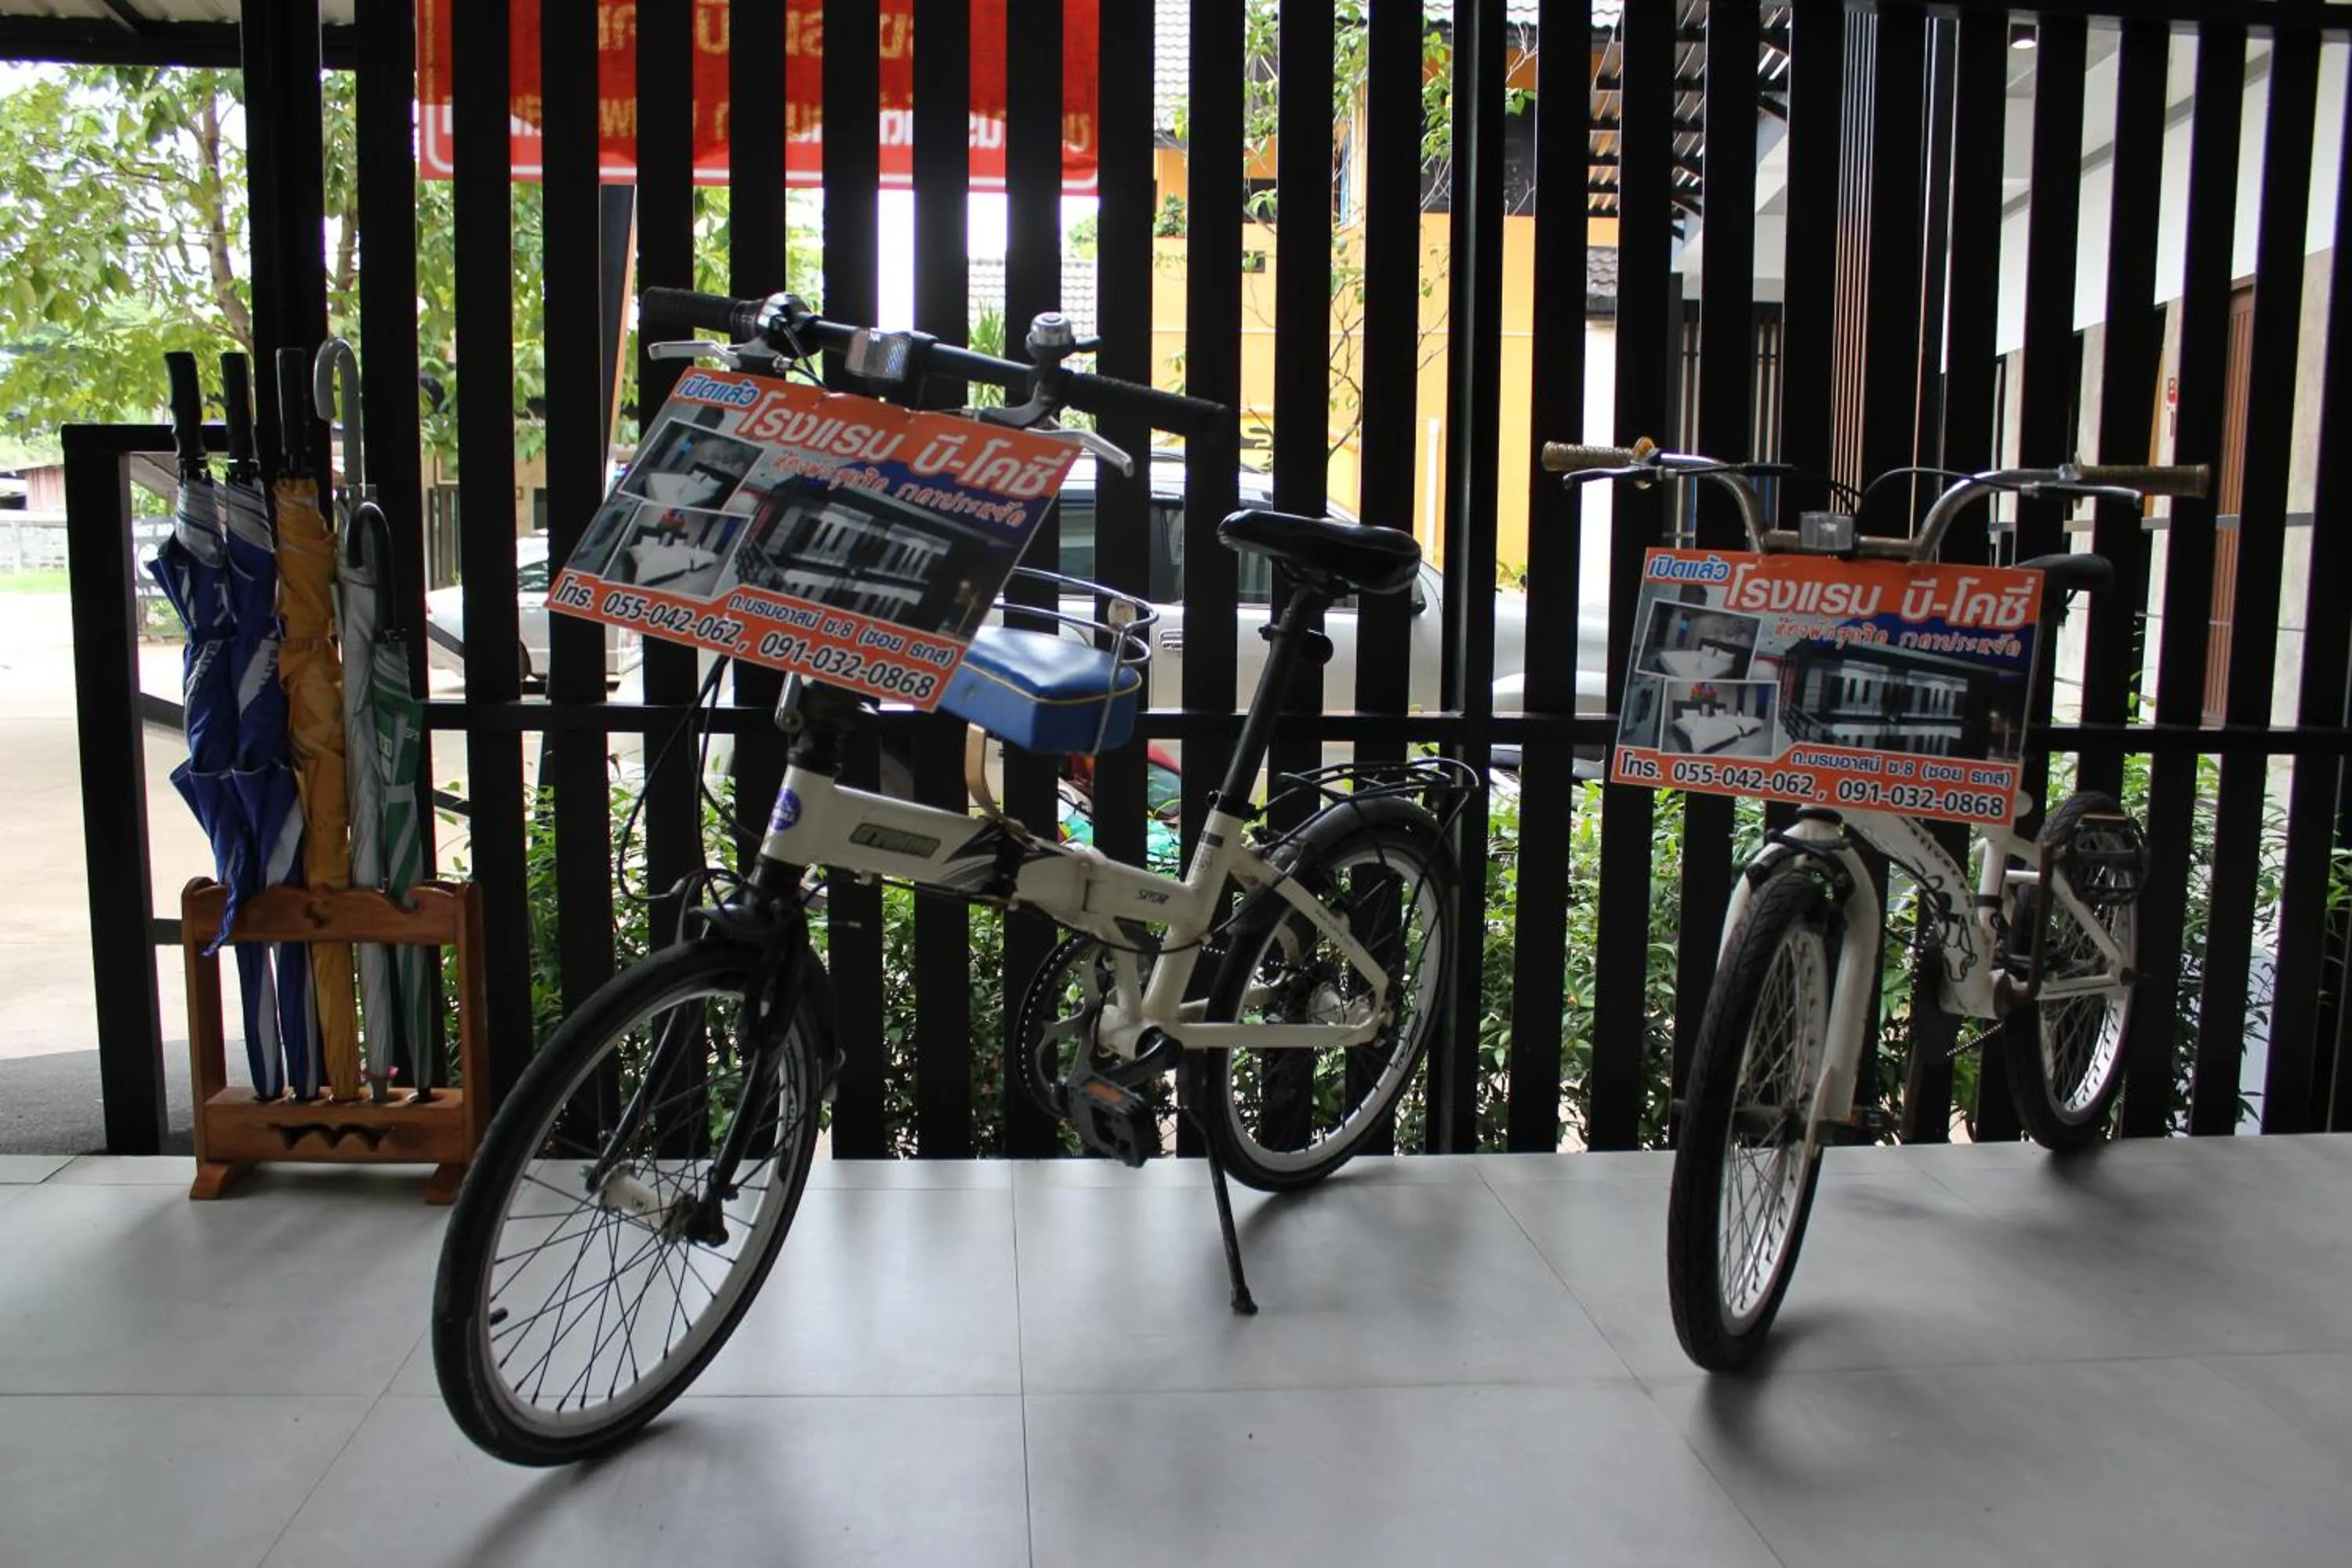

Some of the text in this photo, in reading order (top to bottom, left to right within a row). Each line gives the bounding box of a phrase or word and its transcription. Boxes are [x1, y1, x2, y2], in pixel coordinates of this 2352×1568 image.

[677, 375, 760, 406] เปิดแล้ว
[735, 390, 1073, 498] โรงแรม บี-โคซี่
[1647, 554, 1731, 582] เปิดแล้ว
[1726, 562, 2036, 628] โรงแรม บี-โคซี่
[554, 575, 936, 699] โทร. 055-042-062, 091-032-0868
[823, 618, 854, 638] ซ.8
[858, 626, 903, 653] (ซอย
[909, 638, 956, 668] ธกส)
[1620, 750, 2005, 818] โทร. 055-042-062, 091-032-0868
[1887, 762, 1914, 777] ซ.8
[1922, 761, 1962, 782] (ซอย
[1970, 770, 2013, 789] ธกส)
